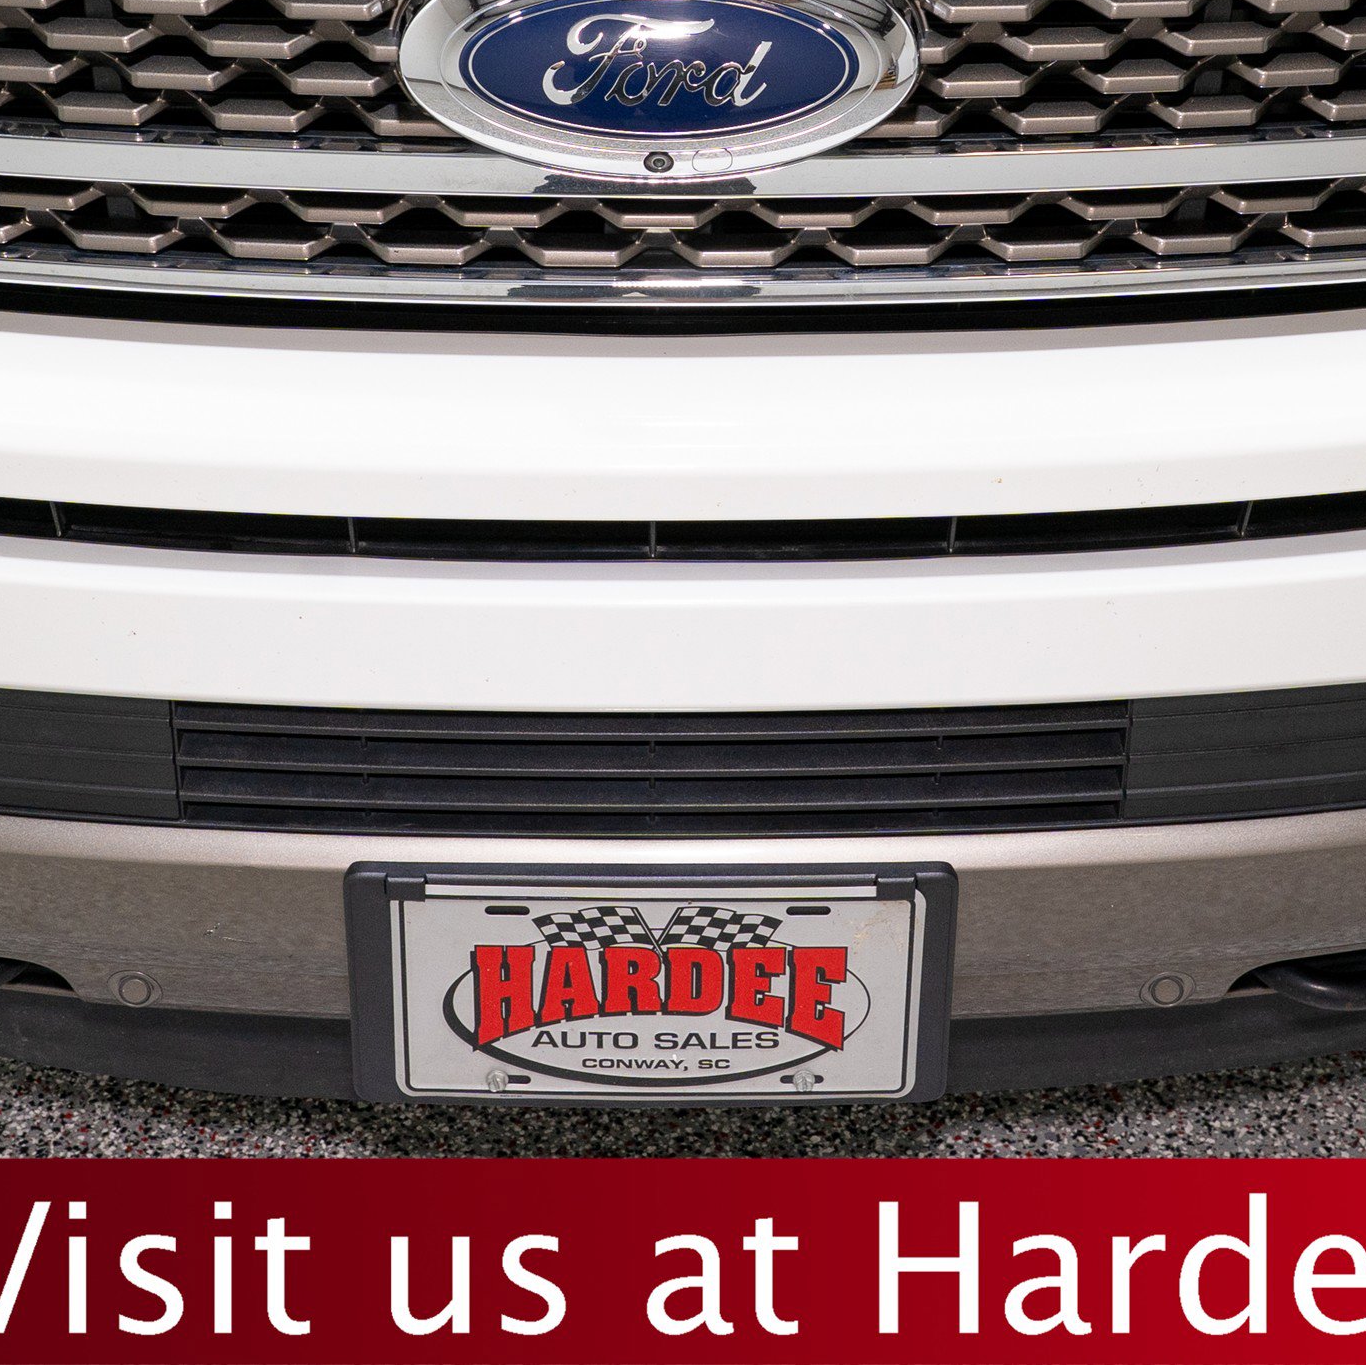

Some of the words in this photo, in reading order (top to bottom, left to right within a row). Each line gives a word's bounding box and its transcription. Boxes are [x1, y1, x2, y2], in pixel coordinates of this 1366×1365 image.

[542, 13, 772, 107] Ford
[470, 943, 849, 1052] HARDEE
[531, 1030, 640, 1050] AUTO
[653, 1031, 780, 1050] SALES
[581, 1057, 689, 1072] CONWAY,
[697, 1058, 731, 1070] SC
